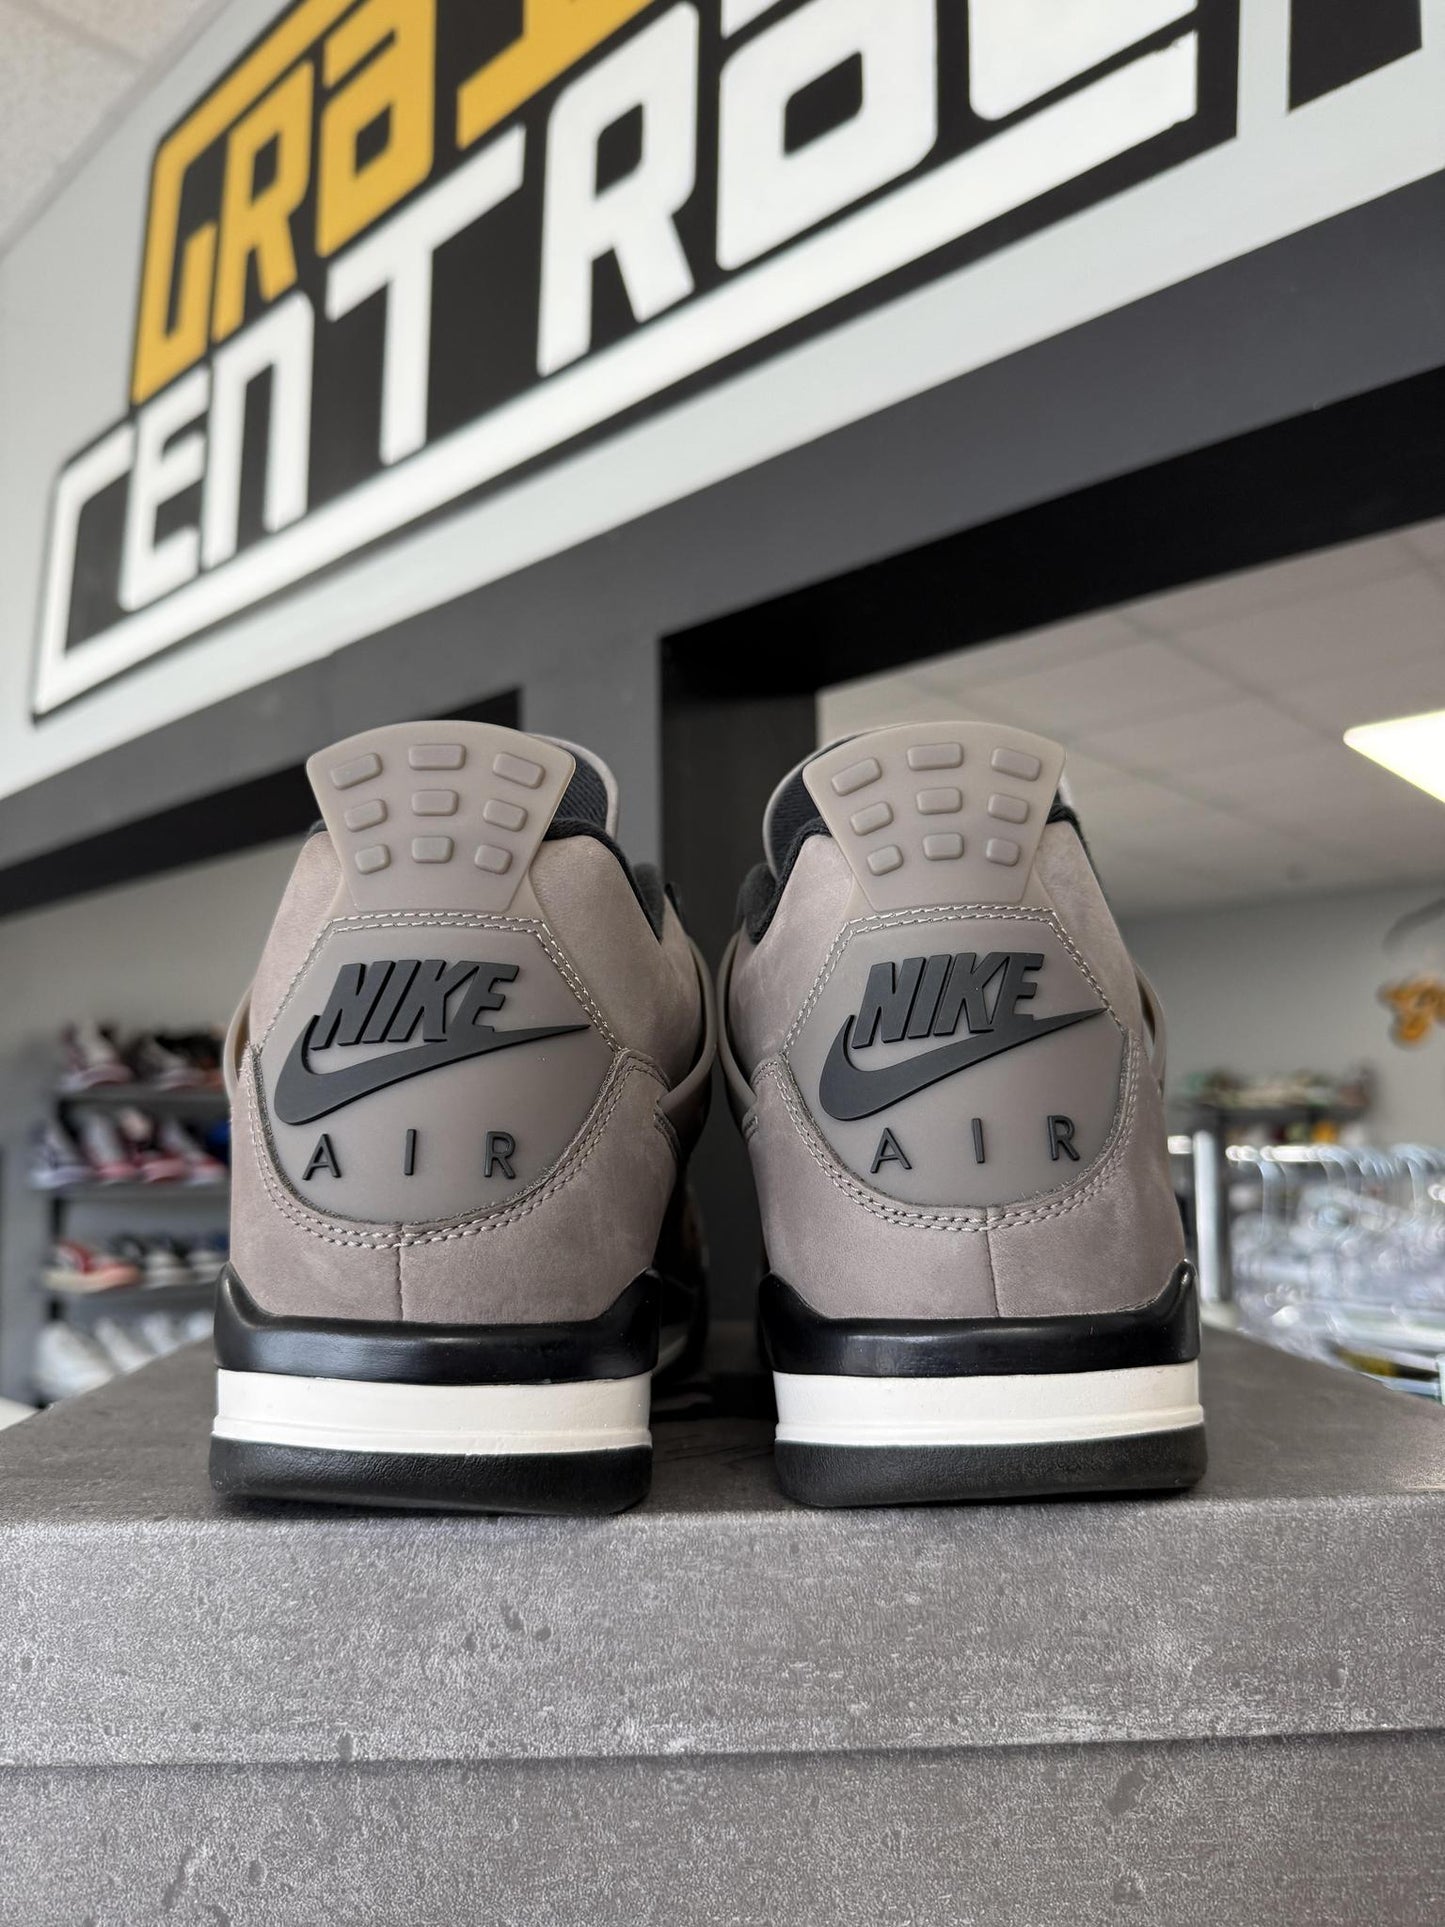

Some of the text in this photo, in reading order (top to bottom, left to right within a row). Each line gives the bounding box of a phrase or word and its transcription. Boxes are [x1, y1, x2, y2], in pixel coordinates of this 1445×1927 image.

[310, 959, 520, 1051] NIKE
[850, 951, 1045, 1050] NIKE
[302, 1128, 517, 1181] AIR
[869, 1114, 1081, 1174] AIR
